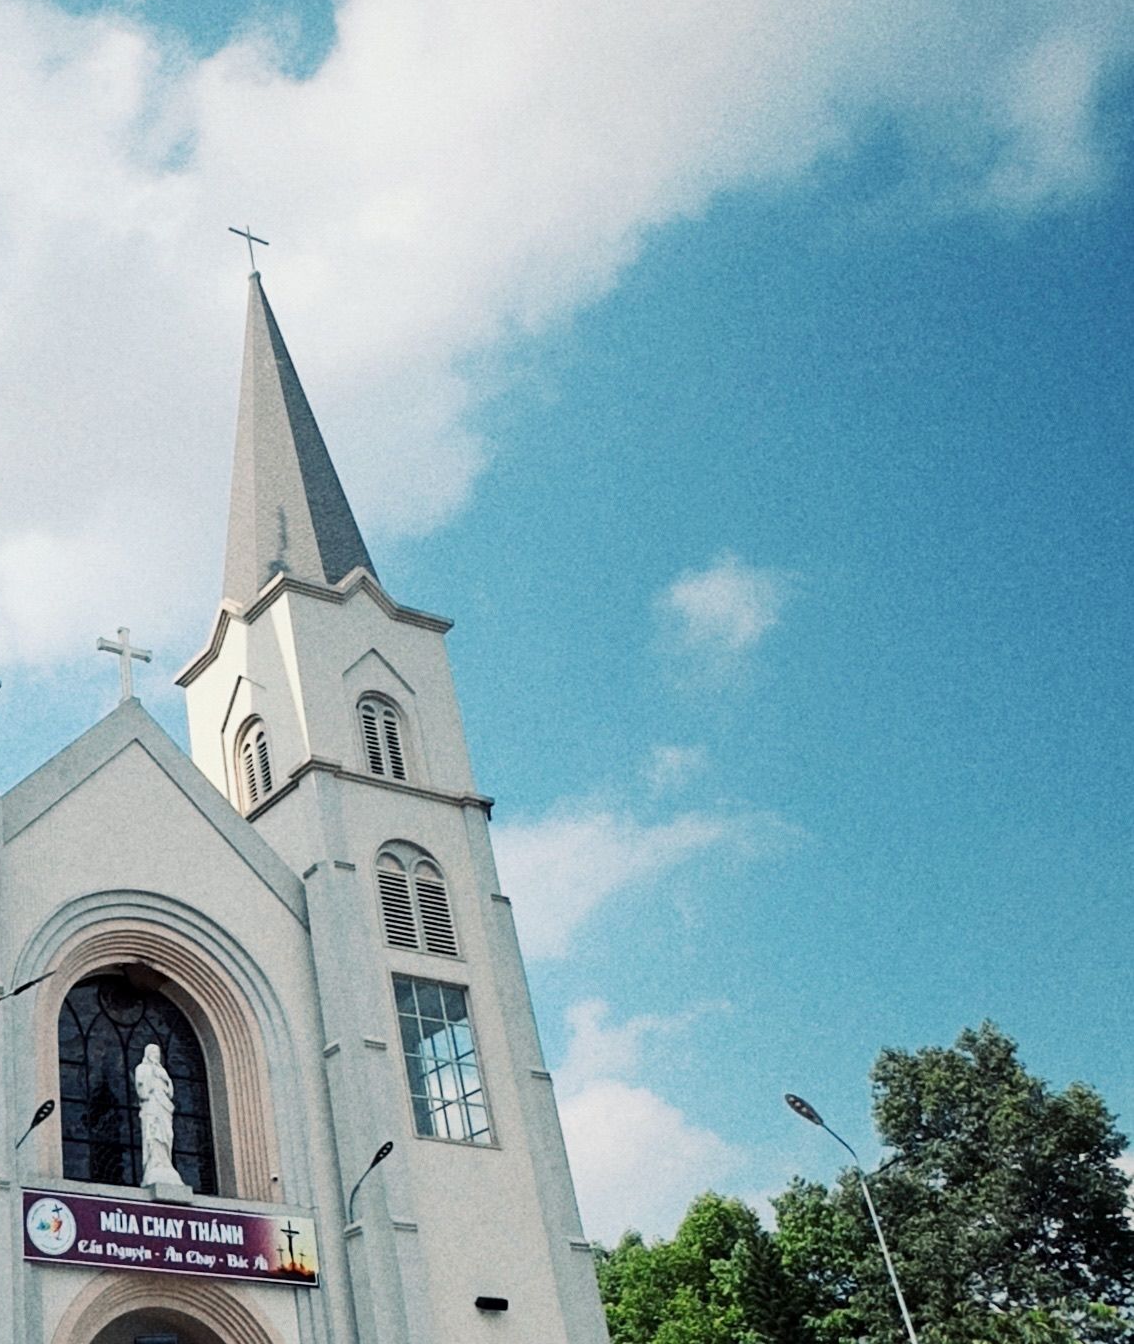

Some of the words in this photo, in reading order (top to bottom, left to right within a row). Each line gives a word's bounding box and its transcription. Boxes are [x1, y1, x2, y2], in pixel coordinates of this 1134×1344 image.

[100, 1208, 140, 1235] MÙA
[142, 1215, 184, 1239] CHAY
[188, 1218, 244, 1245] THÁNH
